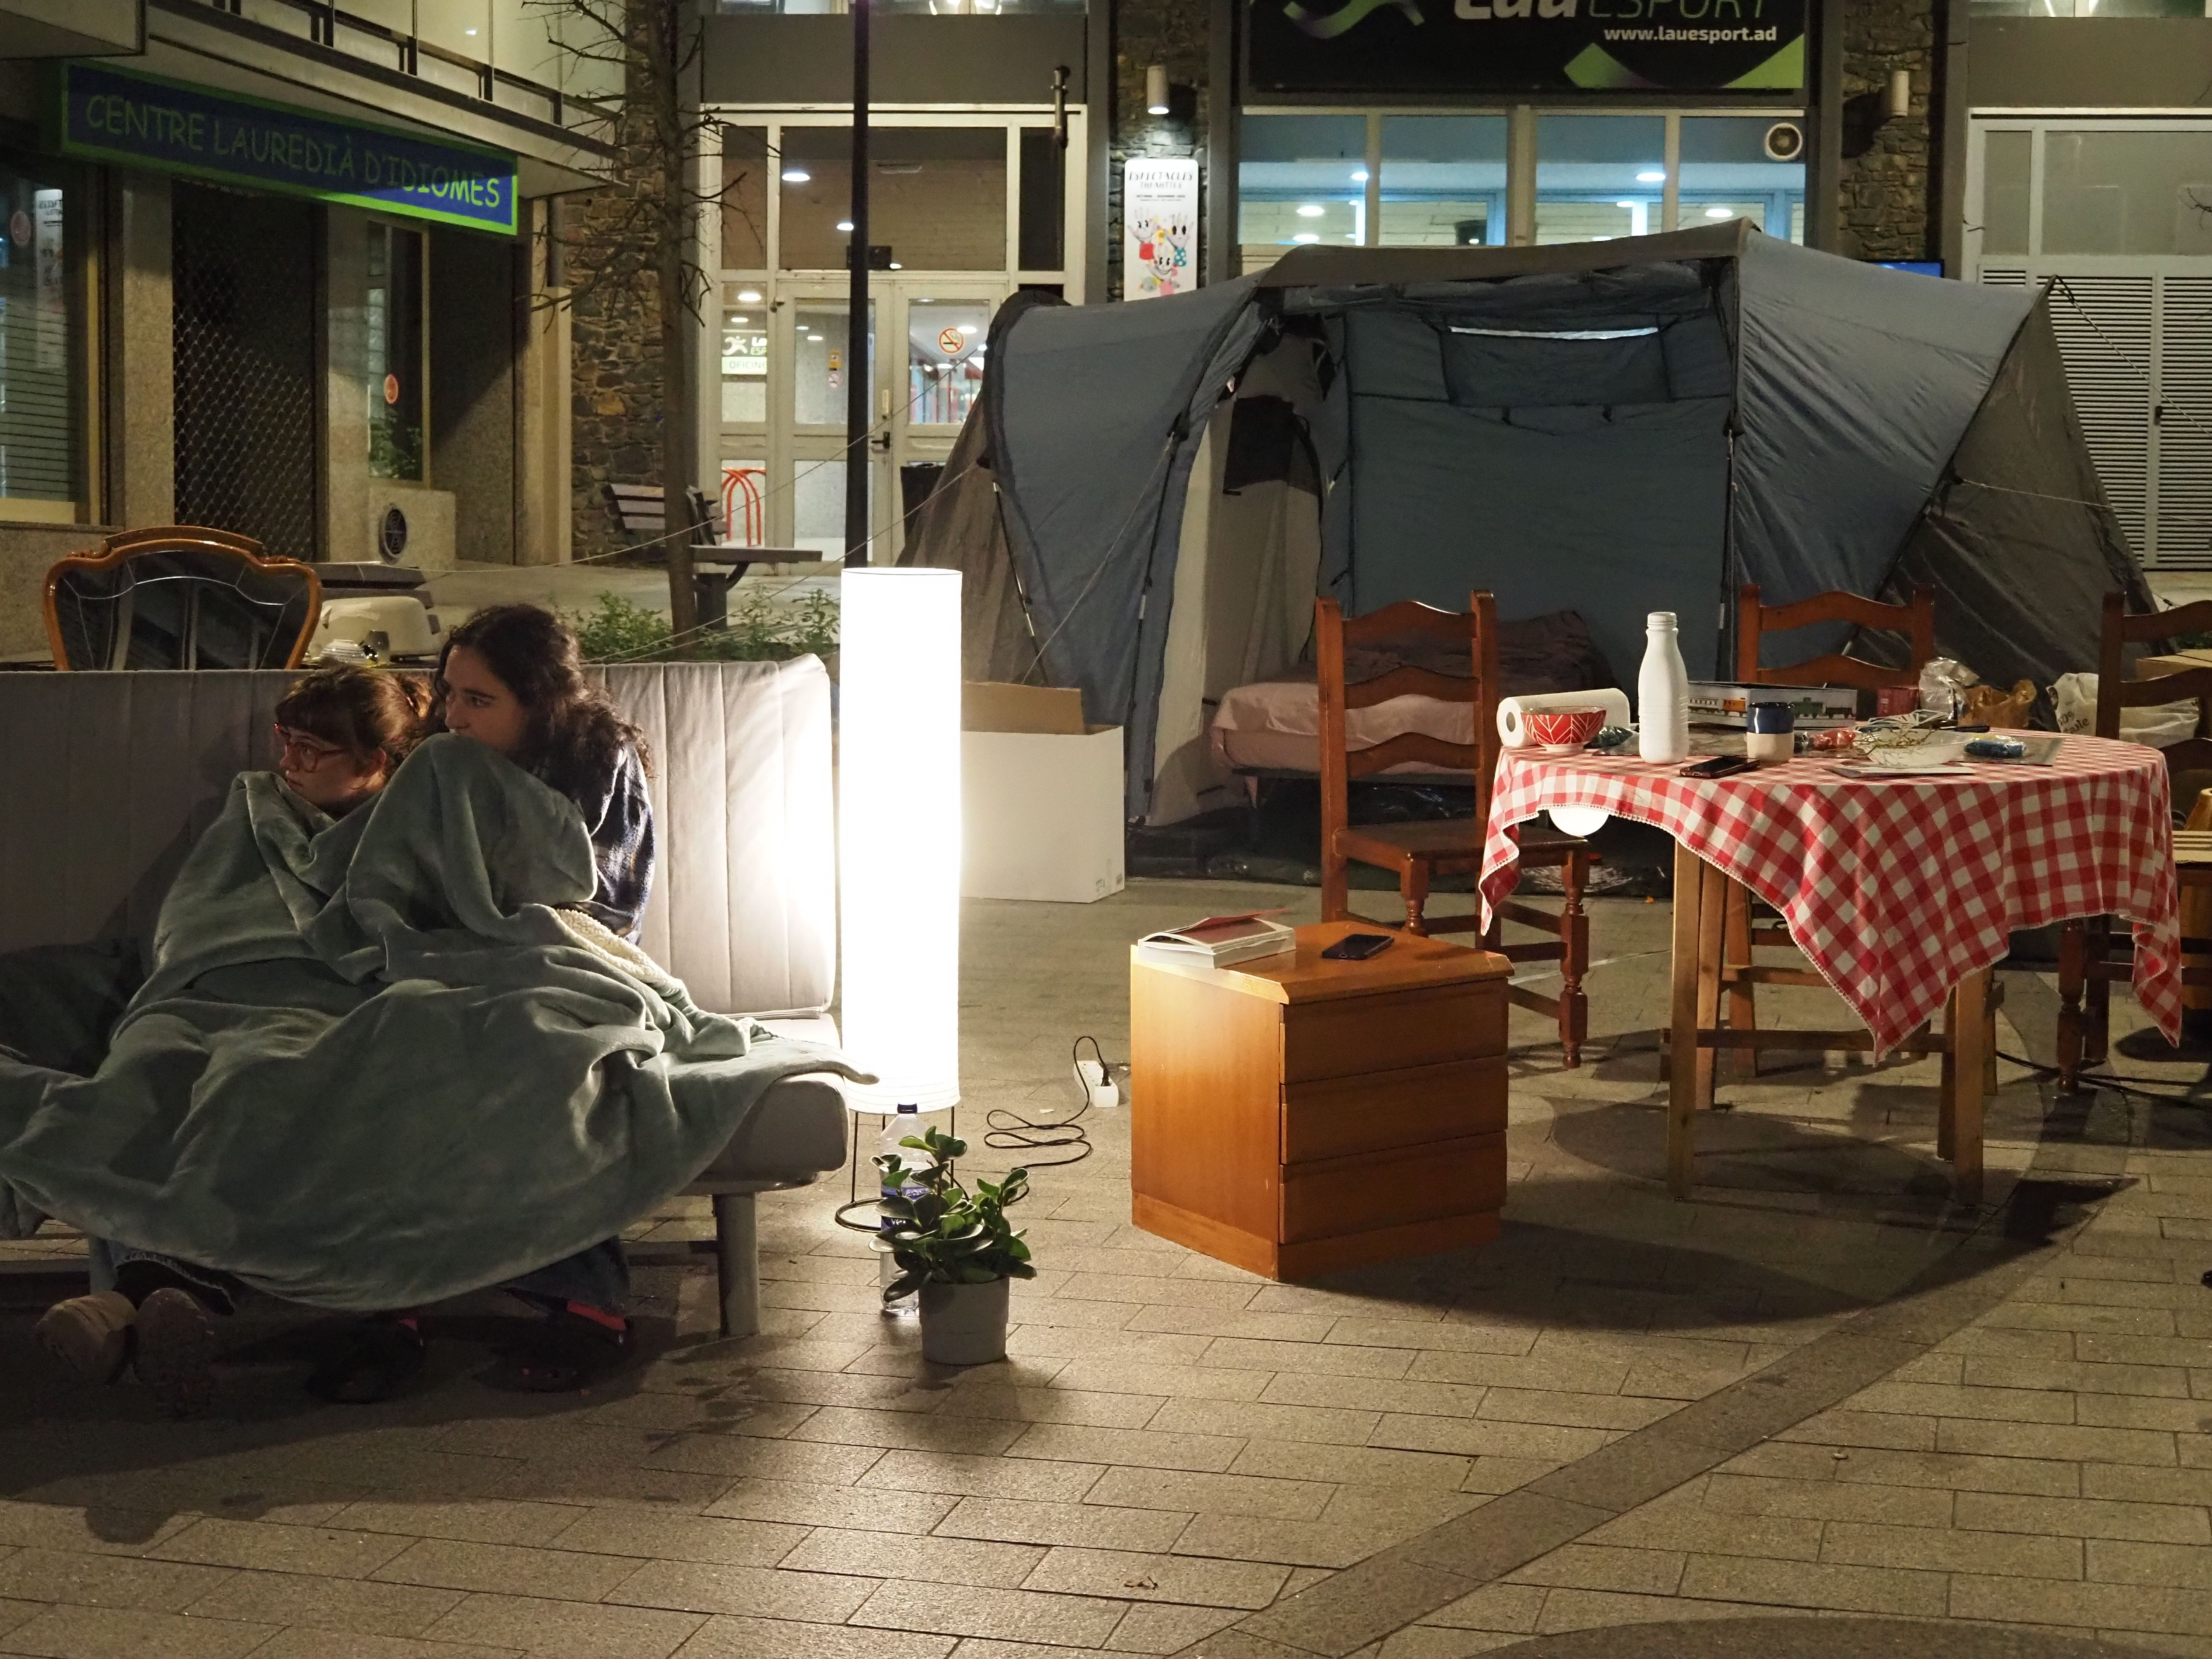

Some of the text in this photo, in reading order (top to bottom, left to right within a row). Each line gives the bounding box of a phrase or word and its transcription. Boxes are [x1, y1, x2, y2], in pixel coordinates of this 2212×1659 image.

[1604, 26, 1778, 44] www.lauesport.ad
[85, 95, 204, 151] CENTRE
[214, 117, 355, 179] LAUREDIÀ
